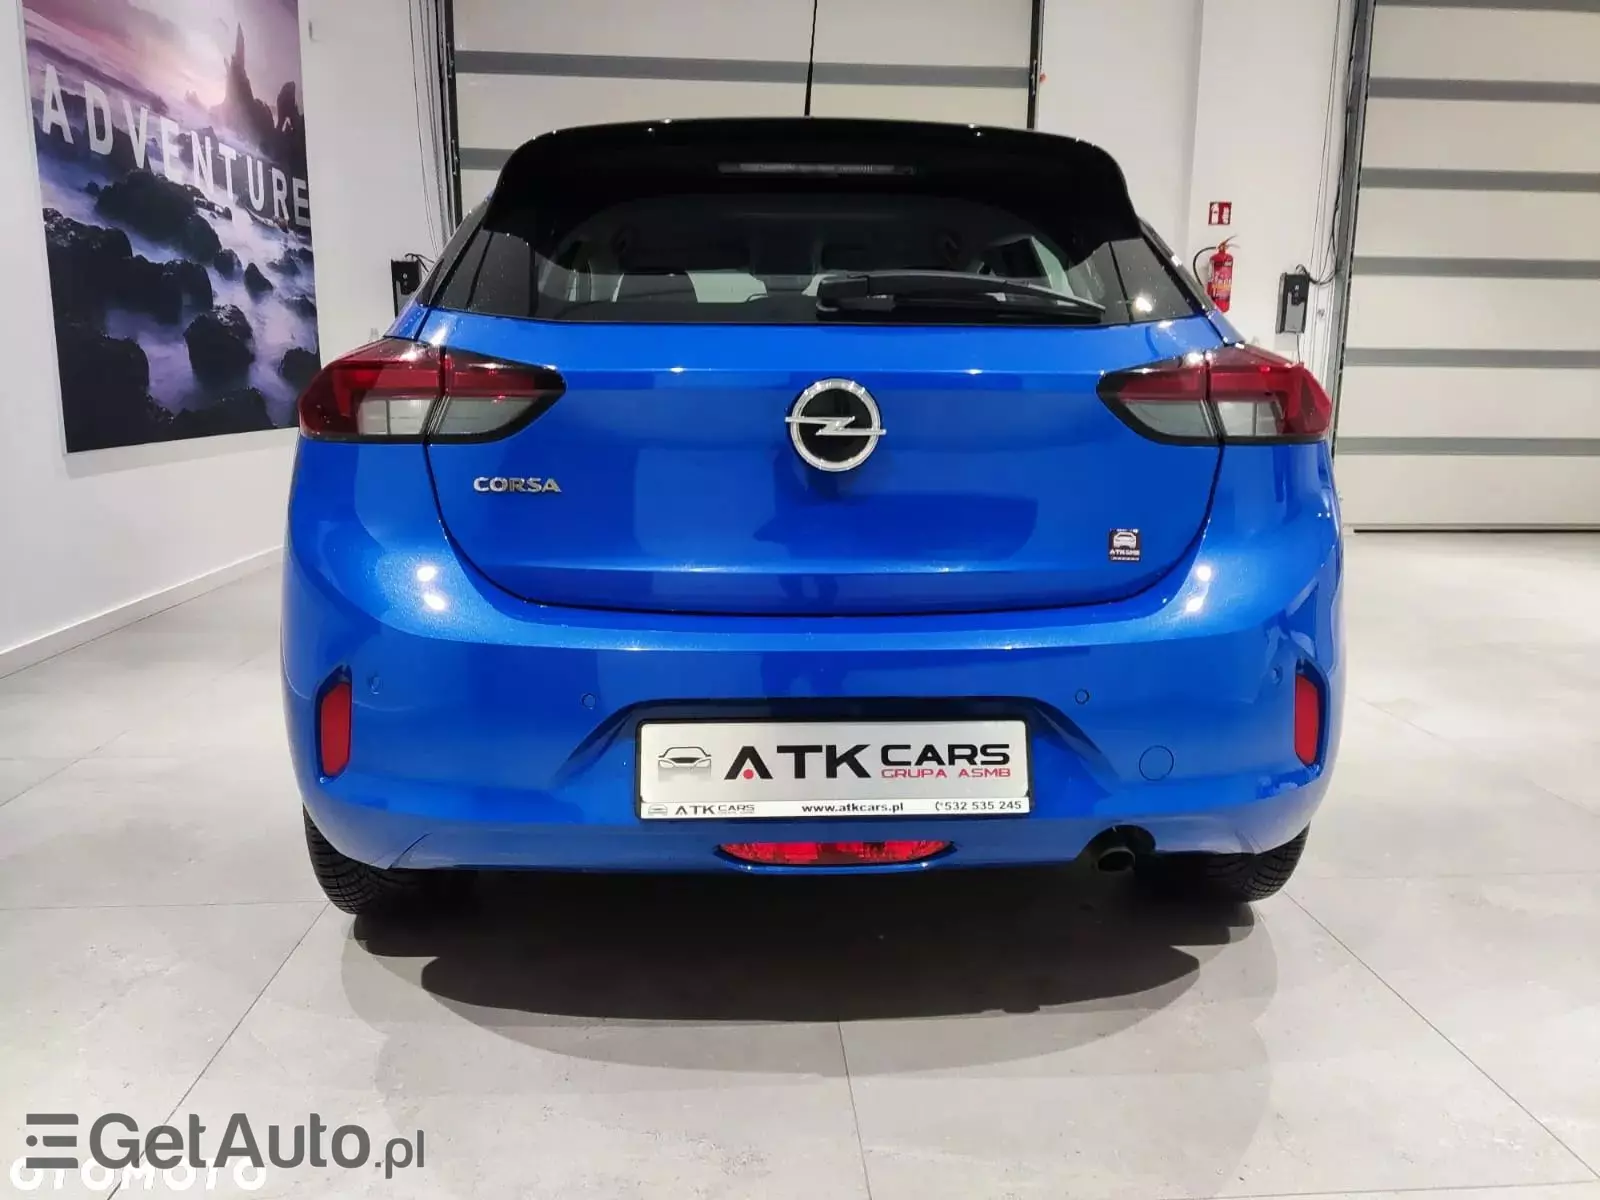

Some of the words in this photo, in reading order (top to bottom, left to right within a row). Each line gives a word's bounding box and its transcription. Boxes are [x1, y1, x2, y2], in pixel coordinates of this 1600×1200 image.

[42, 63, 311, 227] ADVENTURE
[473, 477, 562, 492] CORSA
[723, 743, 871, 780] ATK
[880, 743, 1010, 766] CARS
[881, 768, 947, 779] GRUPA
[958, 768, 1011, 778] ASMB
[675, 805, 715, 815] ATK
[718, 803, 755, 811] CARS
[801, 802, 904, 813] www.atkcars.pl
[945, 801, 967, 811] 532
[971, 801, 995, 810] 535
[999, 800, 1022, 810] 245
